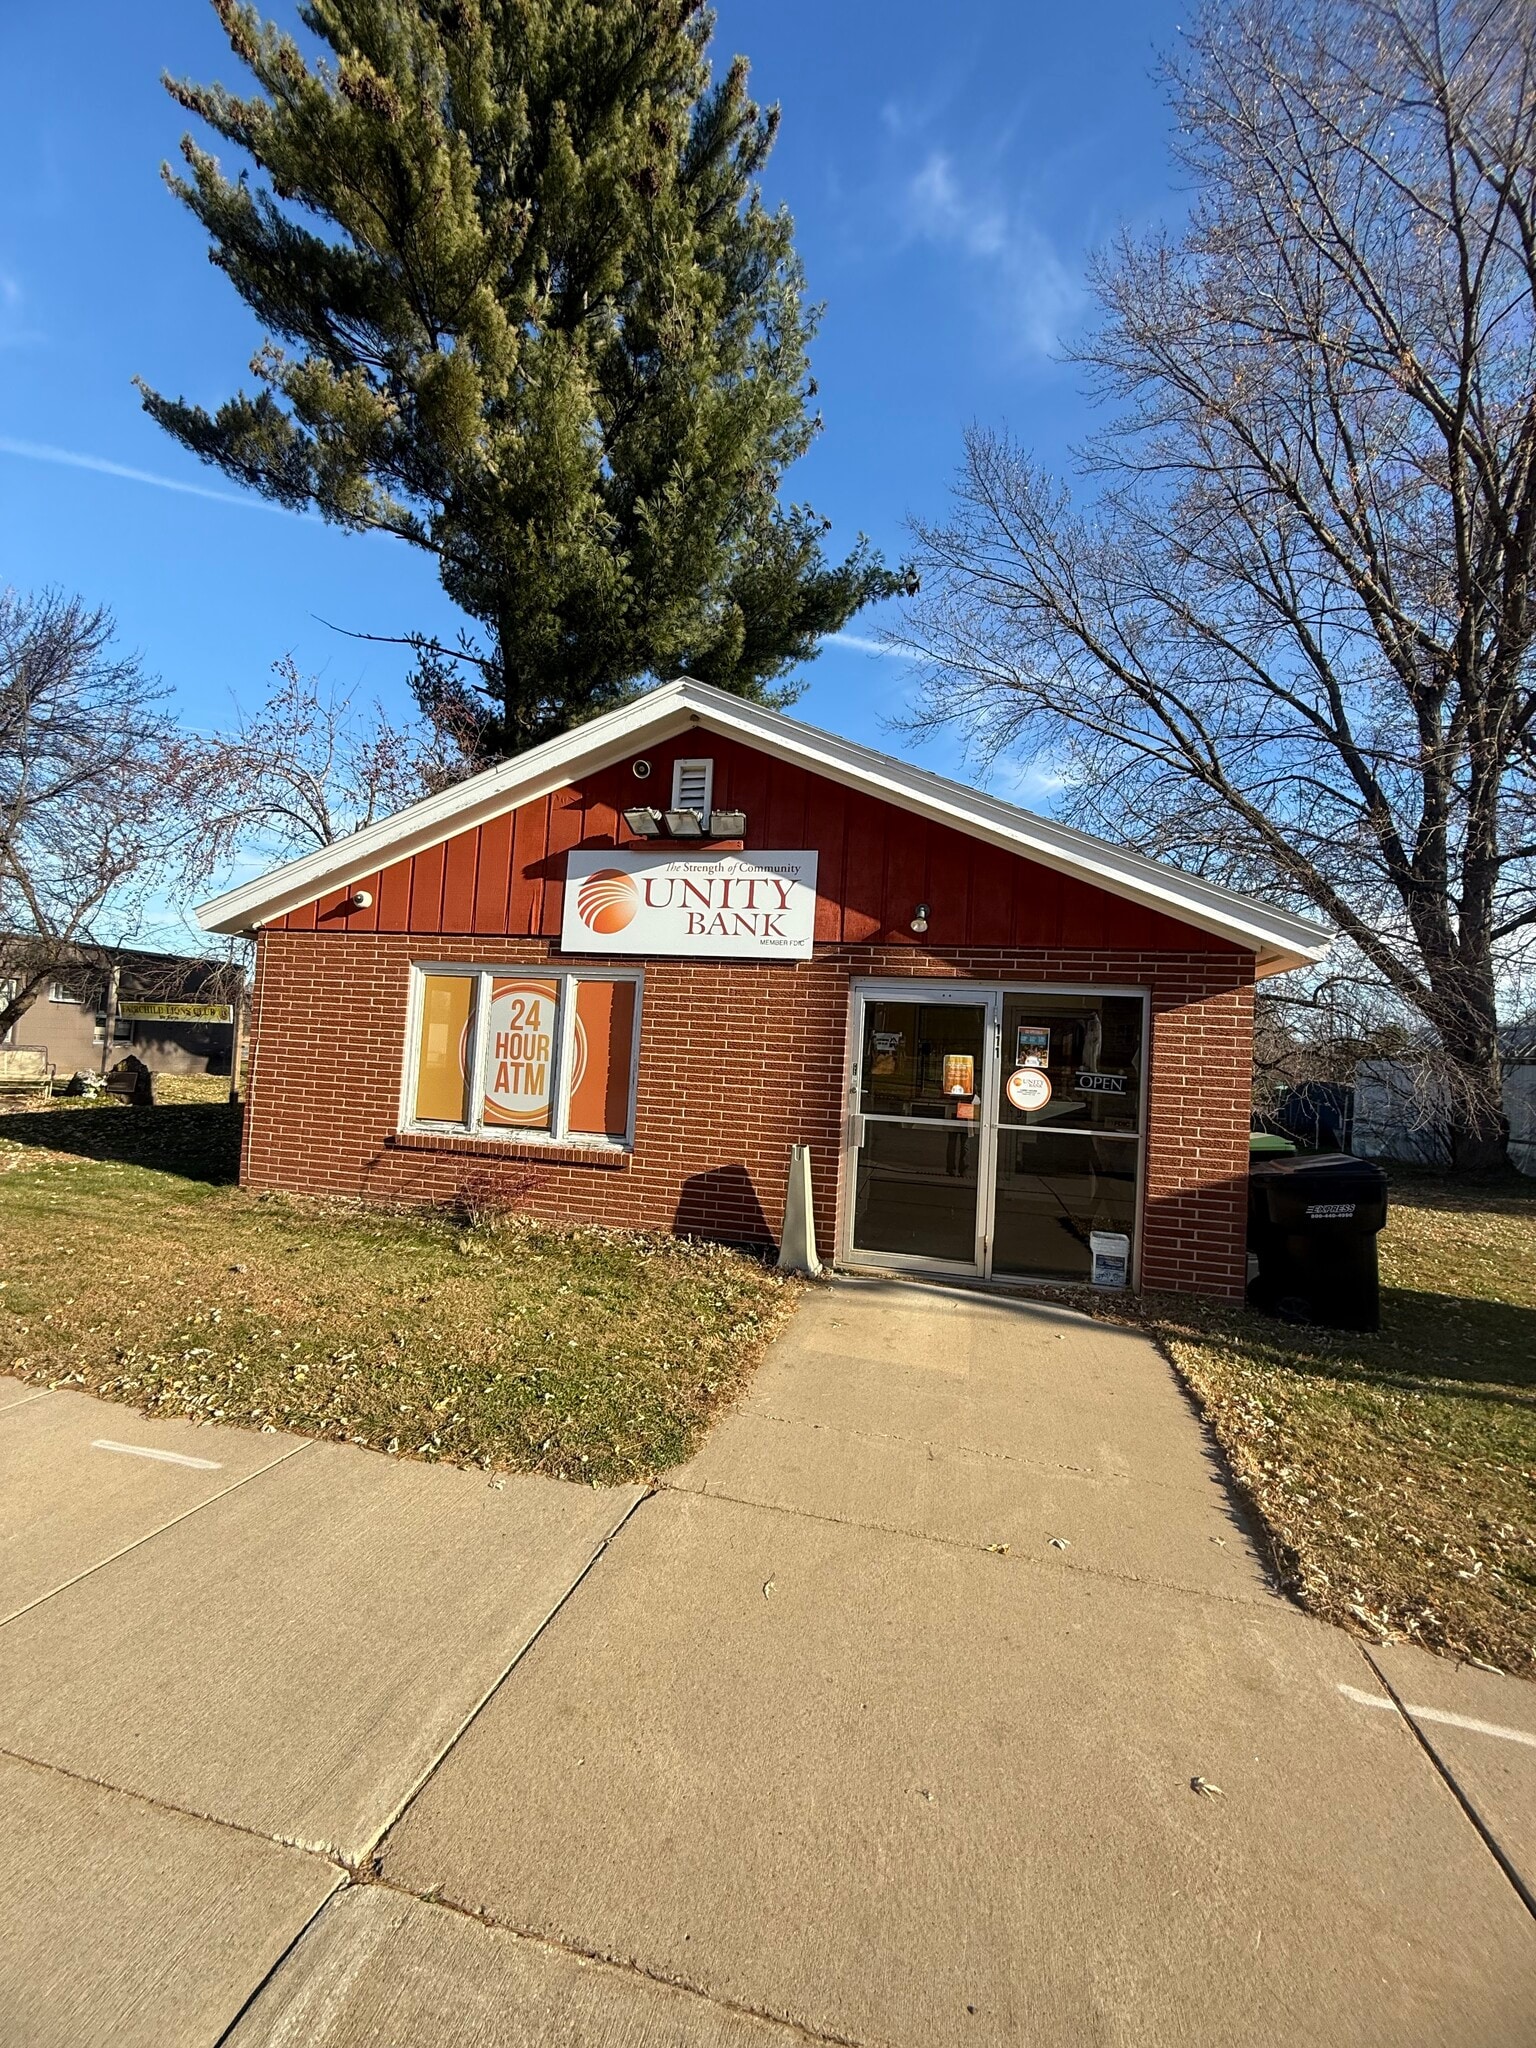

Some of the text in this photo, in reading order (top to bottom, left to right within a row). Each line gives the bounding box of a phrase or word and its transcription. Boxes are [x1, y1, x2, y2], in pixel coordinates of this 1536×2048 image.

[666, 862, 801, 876] The Strength of Community
[641, 877, 802, 910] UNITY
[684, 912, 787, 937] BANK
[166, 1006, 191, 1016] LIONS
[193, 1008, 215, 1016] CLUB
[510, 999, 541, 1031] 24
[495, 1032, 549, 1062] HOUR
[494, 1060, 546, 1096] ATM
[1079, 1075, 1123, 1091] OPEN
[1312, 1203, 1356, 1213] EXPRESS
